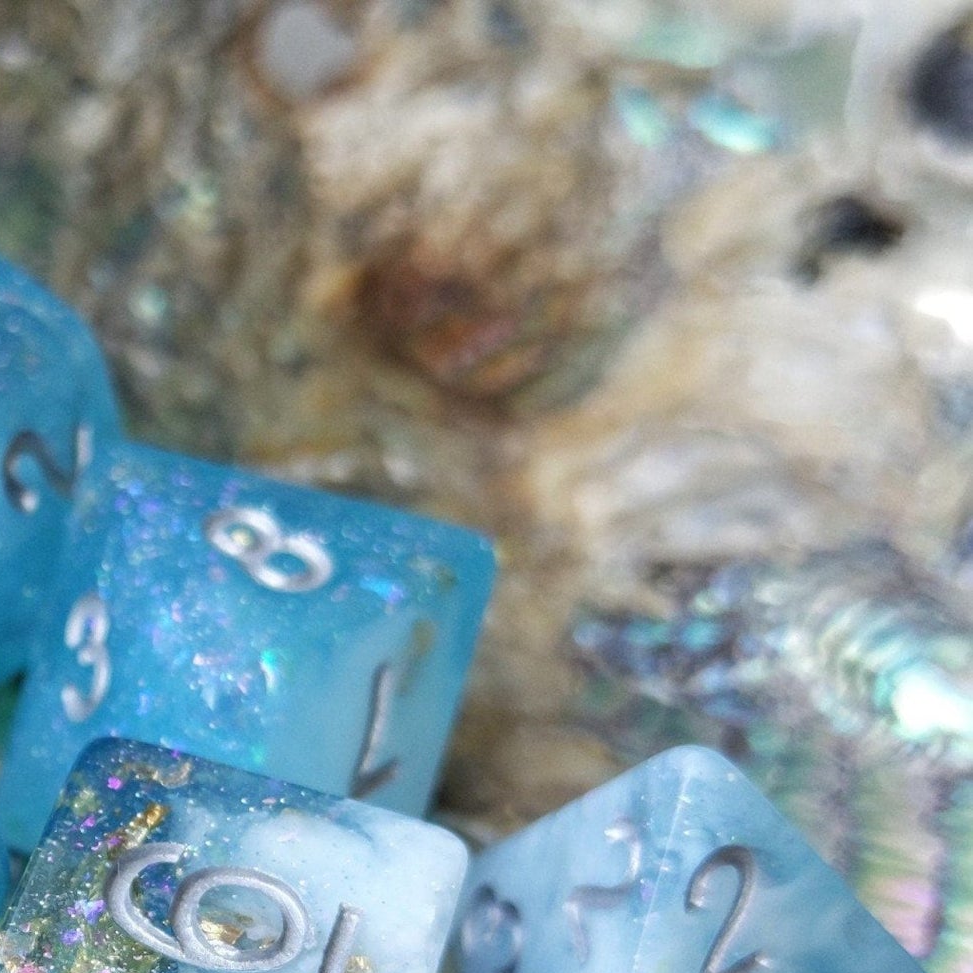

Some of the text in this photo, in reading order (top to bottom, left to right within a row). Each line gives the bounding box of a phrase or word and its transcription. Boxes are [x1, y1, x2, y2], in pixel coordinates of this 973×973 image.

[0, 424, 94, 513] 2
[202, 505, 334, 593] 8
[61, 594, 112, 723] 3
